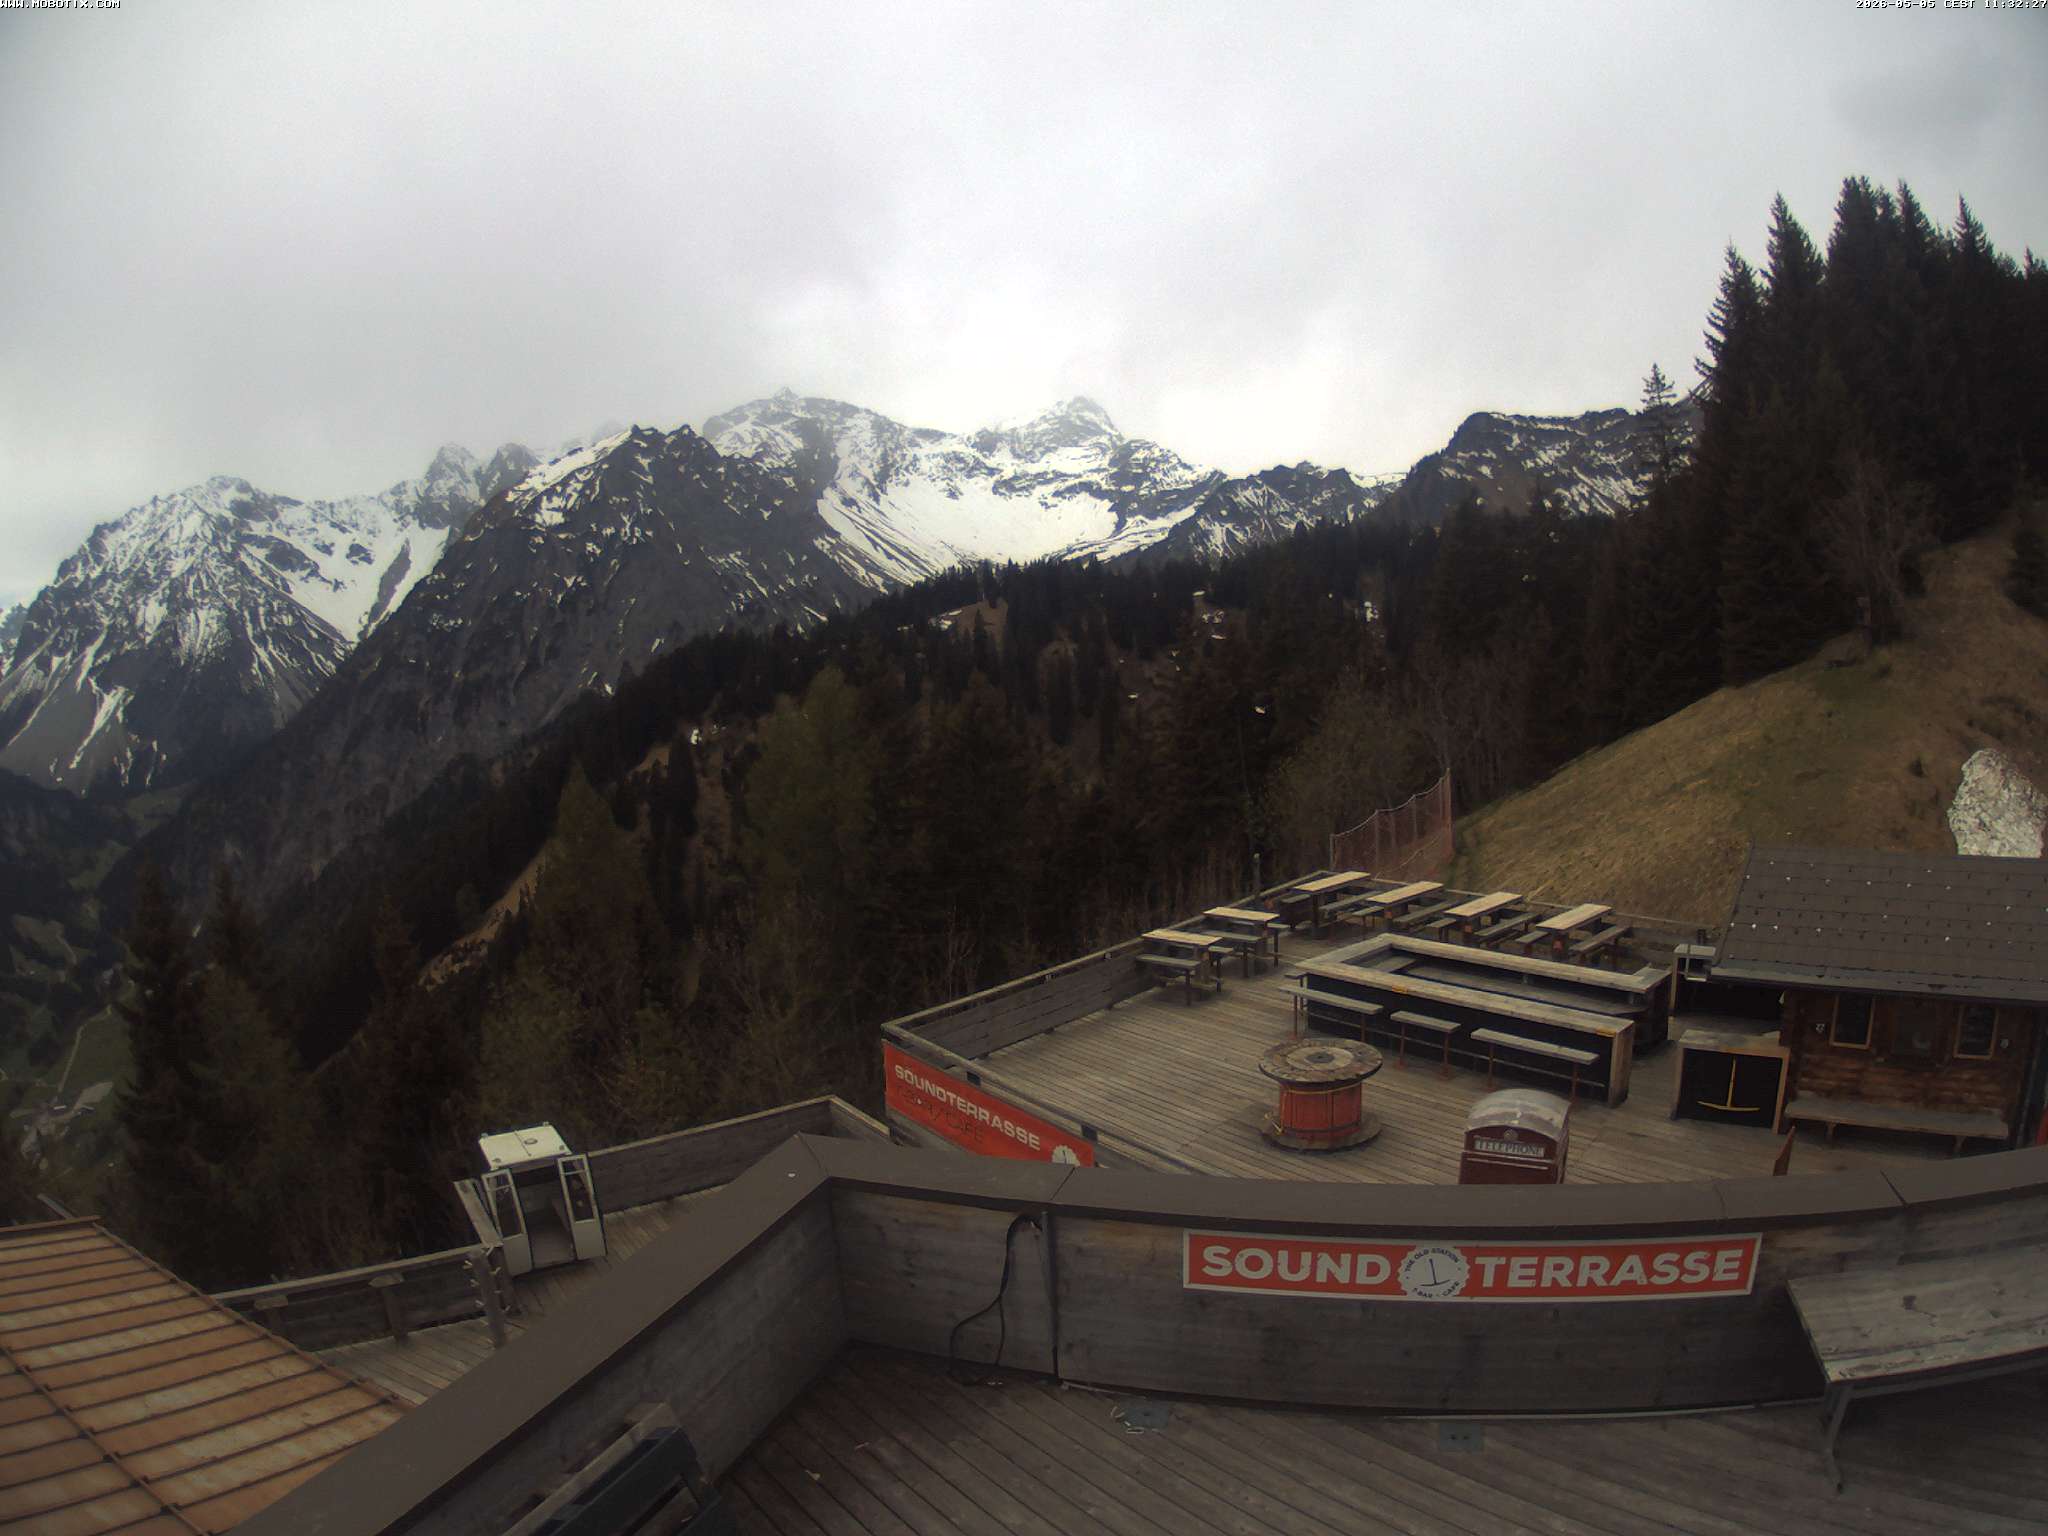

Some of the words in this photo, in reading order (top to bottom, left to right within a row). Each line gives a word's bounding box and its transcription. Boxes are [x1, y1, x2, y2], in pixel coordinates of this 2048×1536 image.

[894, 1064, 1041, 1151] SOUNDTERRASSE
[1201, 1245, 1391, 1285] SOUND
[1414, 1248, 1430, 1260] OLD
[1475, 1249, 1743, 1288] TERRASSE
